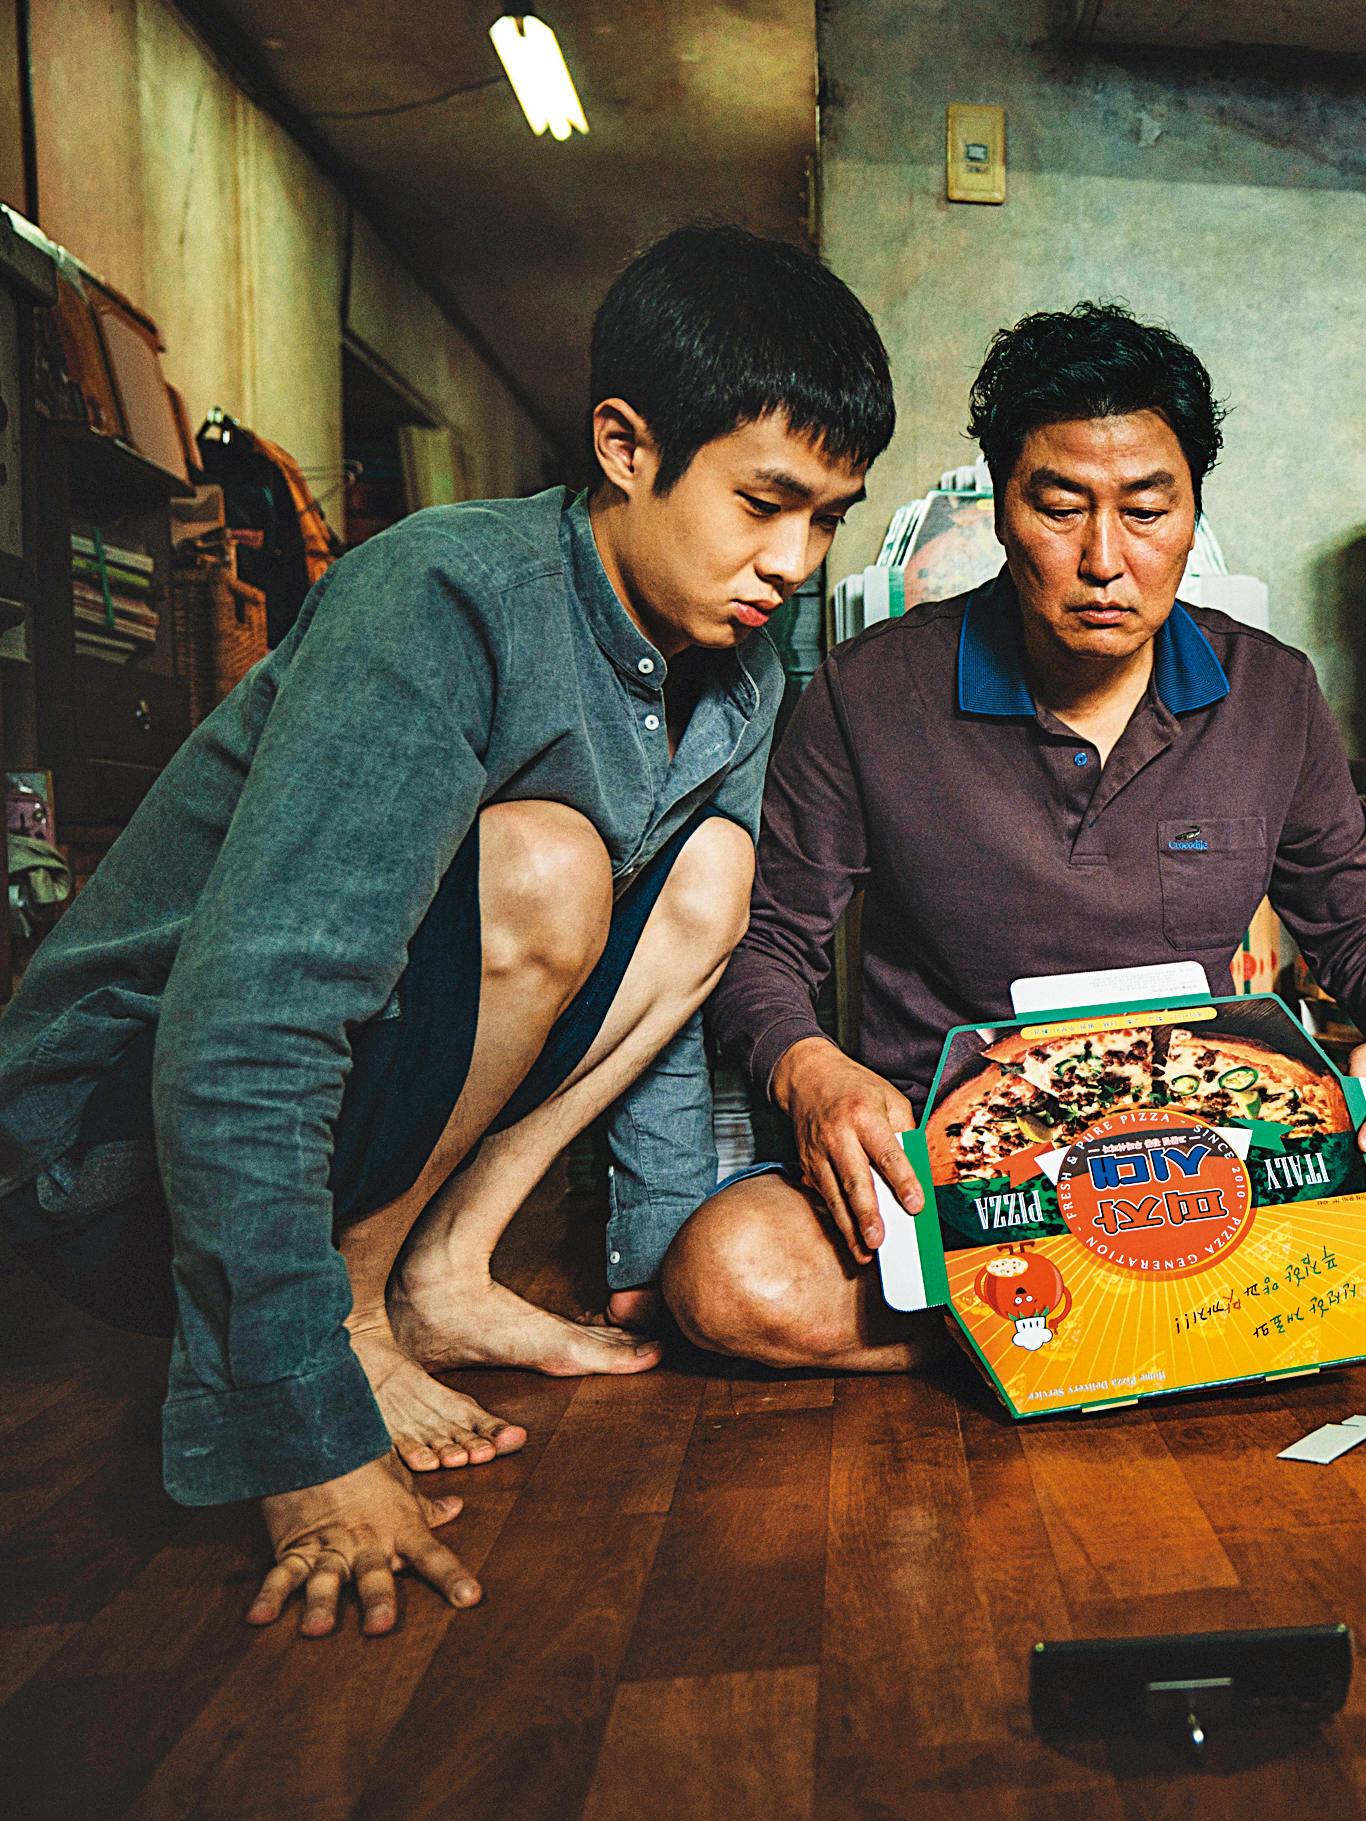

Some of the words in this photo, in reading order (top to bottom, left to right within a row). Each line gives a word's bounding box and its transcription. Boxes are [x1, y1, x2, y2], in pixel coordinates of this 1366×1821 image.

[1168, 840, 1208, 850] Crocodile
[1075, 1120, 1113, 1150] PURE
[1119, 1112, 1170, 1125] PIZZA
[1066, 1155, 1078, 1165] &
[1087, 1143, 1212, 1190] 시대
[1193, 1124, 1235, 1160] SINCE
[1231, 1166, 1246, 1197] 2010
[1265, 1152, 1331, 1191] ITALY
[974, 1189, 1044, 1231] PIZZA
[1059, 1171, 1078, 1220] FRESH
[1092, 1188, 1229, 1236] 피자
[1085, 1235, 1198, 1270] GENERATION
[1204, 1216, 1242, 1255] PIZZA
[1284, 1245, 1338, 1287] 푸짐한
[1243, 1276, 1279, 1296] 양과
[1309, 1282, 1357, 1318] 신선한
[1174, 1288, 1242, 1334] 맛까지!!
[1252, 1306, 1305, 1338] 재료와
[1028, 1387, 1065, 1400] Service
[1067, 1380, 1109, 1394] Delivery
[1110, 1375, 1137, 1386] Pizza
